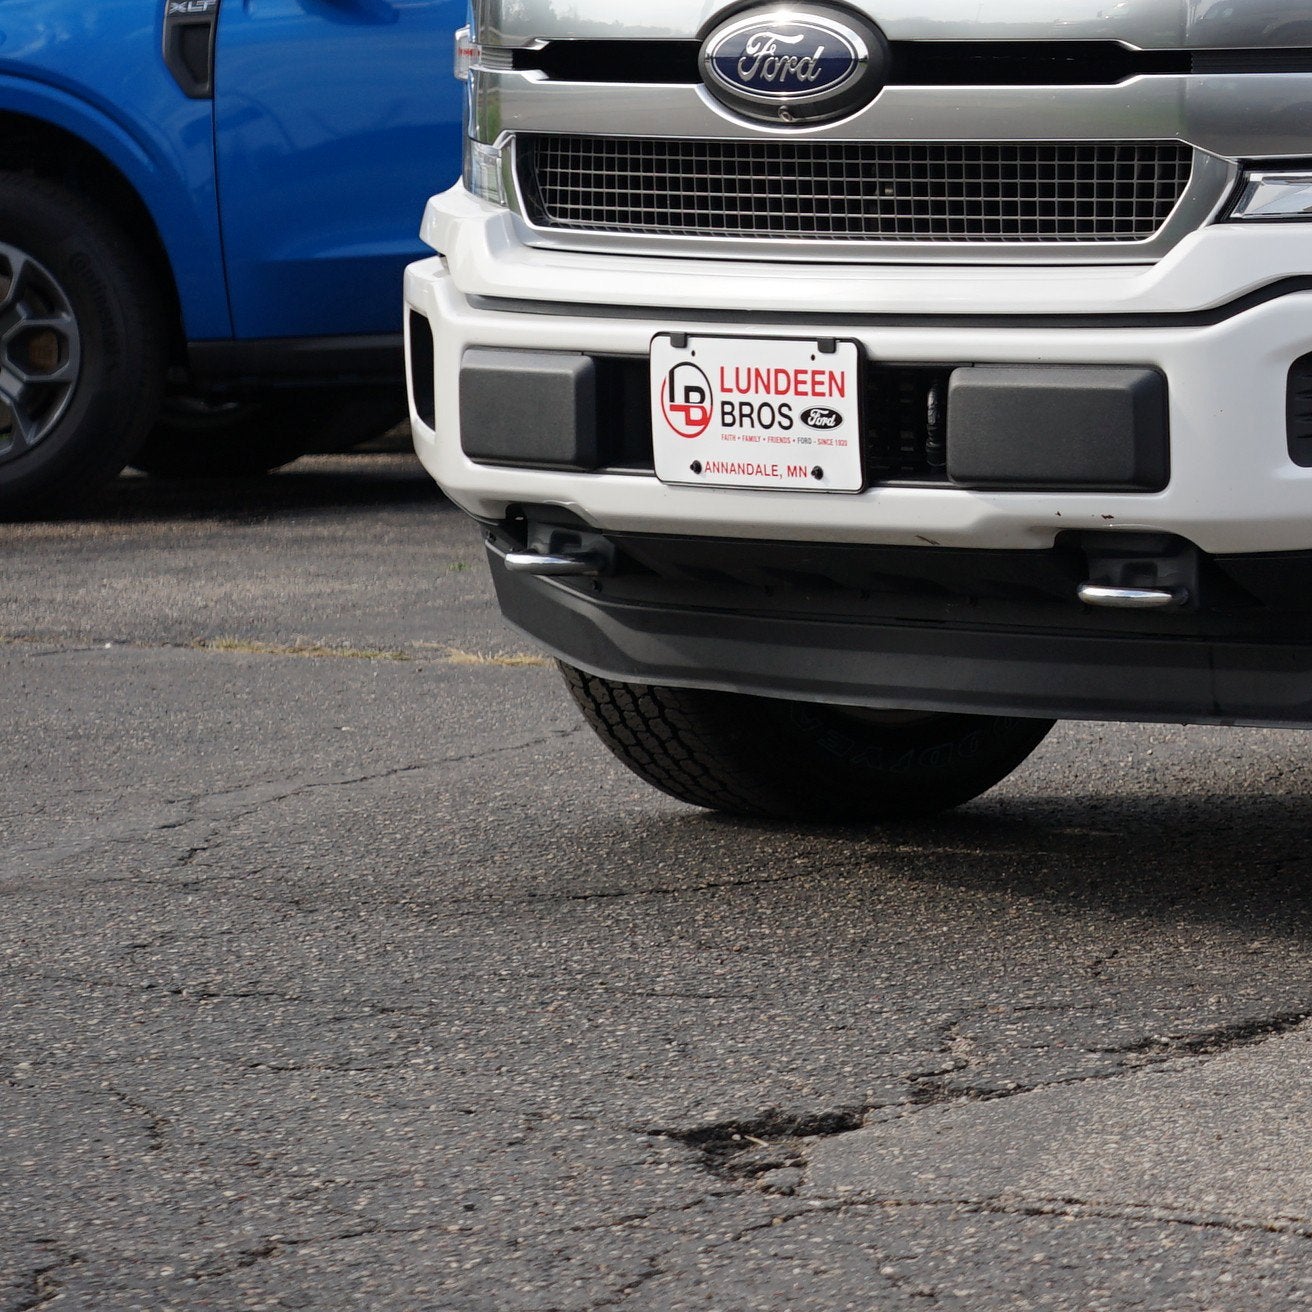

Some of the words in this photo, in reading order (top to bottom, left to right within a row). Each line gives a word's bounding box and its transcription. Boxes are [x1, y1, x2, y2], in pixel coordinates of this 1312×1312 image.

[168, 0, 217, 15] XLT
[737, 31, 825, 82] Ford
[720, 366, 845, 398] LUNDEEN
[721, 400, 794, 430] BROS
[807, 409, 836, 427] Ford
[767, 436, 791, 444] FRIENDS
[818, 438, 834, 446] SINCE
[704, 461, 783, 478] ANNANDALE,
[787, 465, 808, 478] MN
